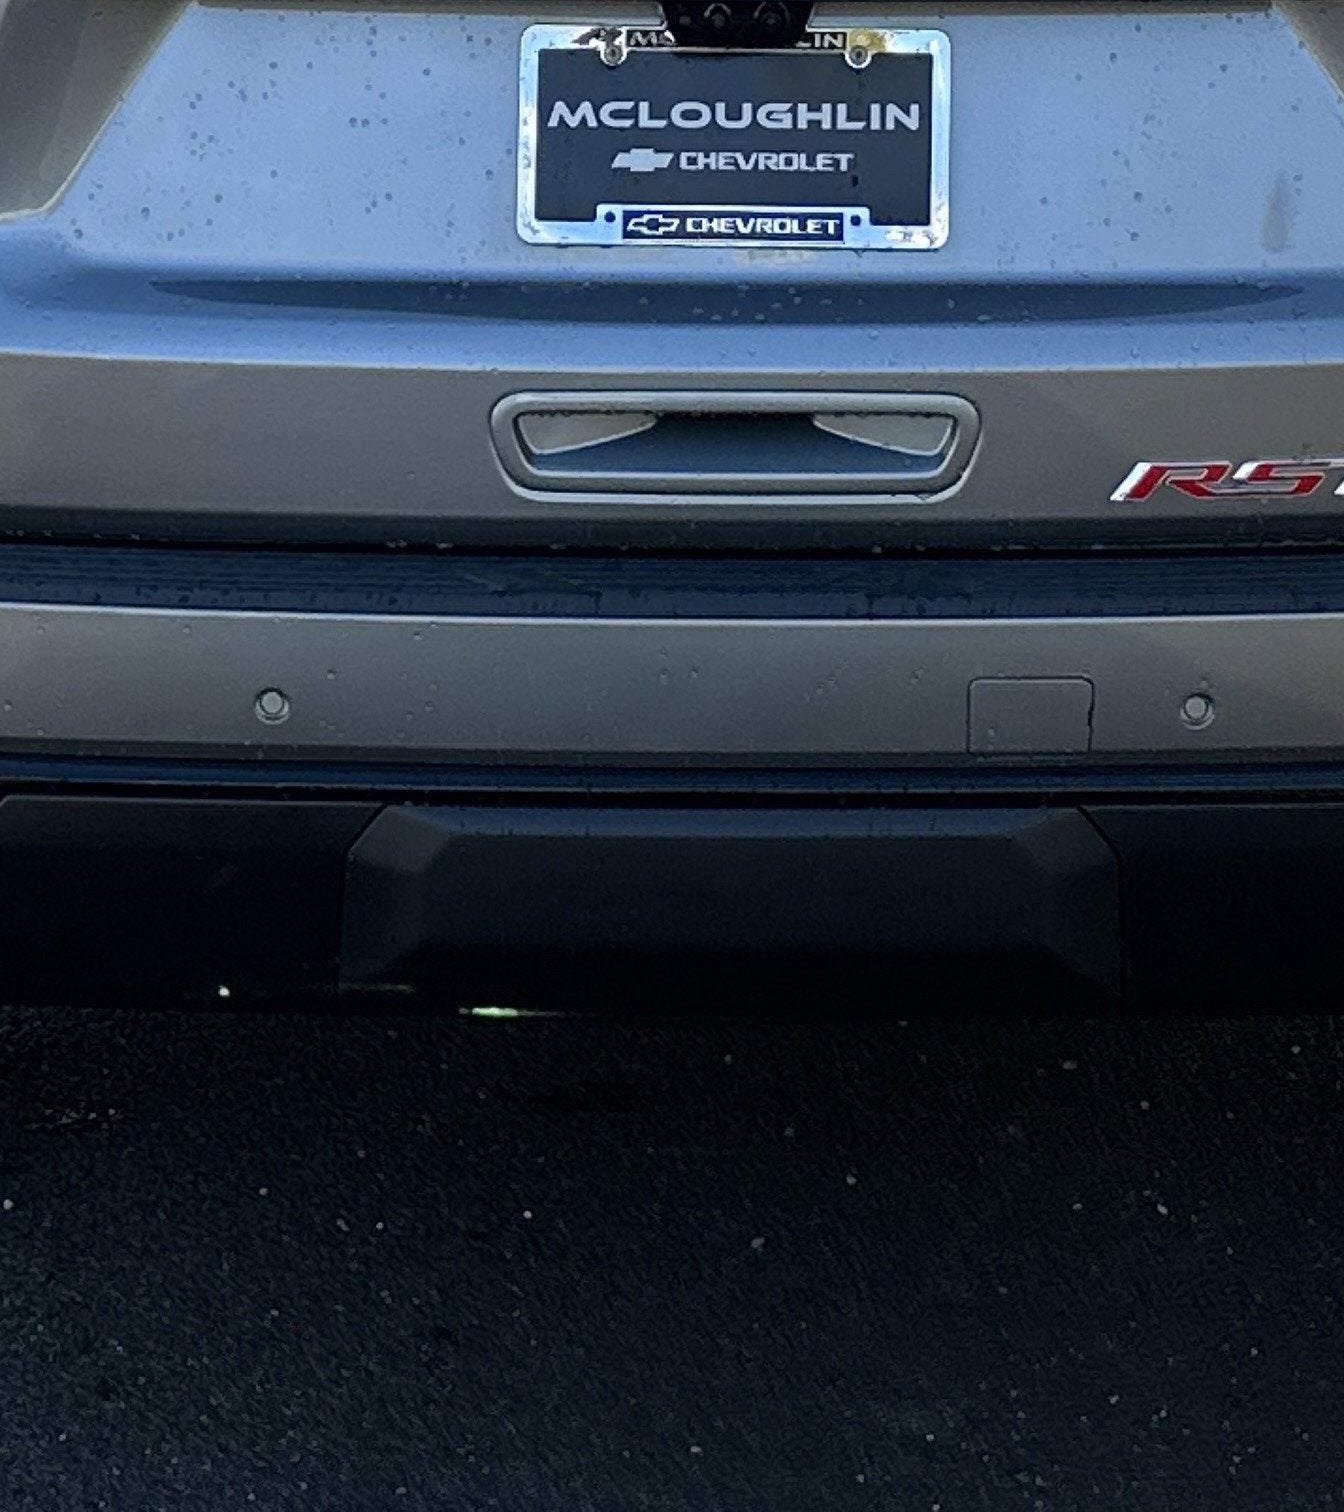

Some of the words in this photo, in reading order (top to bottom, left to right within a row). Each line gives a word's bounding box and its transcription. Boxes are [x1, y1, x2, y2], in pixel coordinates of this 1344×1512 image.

[547, 100, 920, 131] MCLOUGHLIN
[679, 151, 854, 173] CHEVROLET
[685, 215, 842, 236] CHEVROLET
